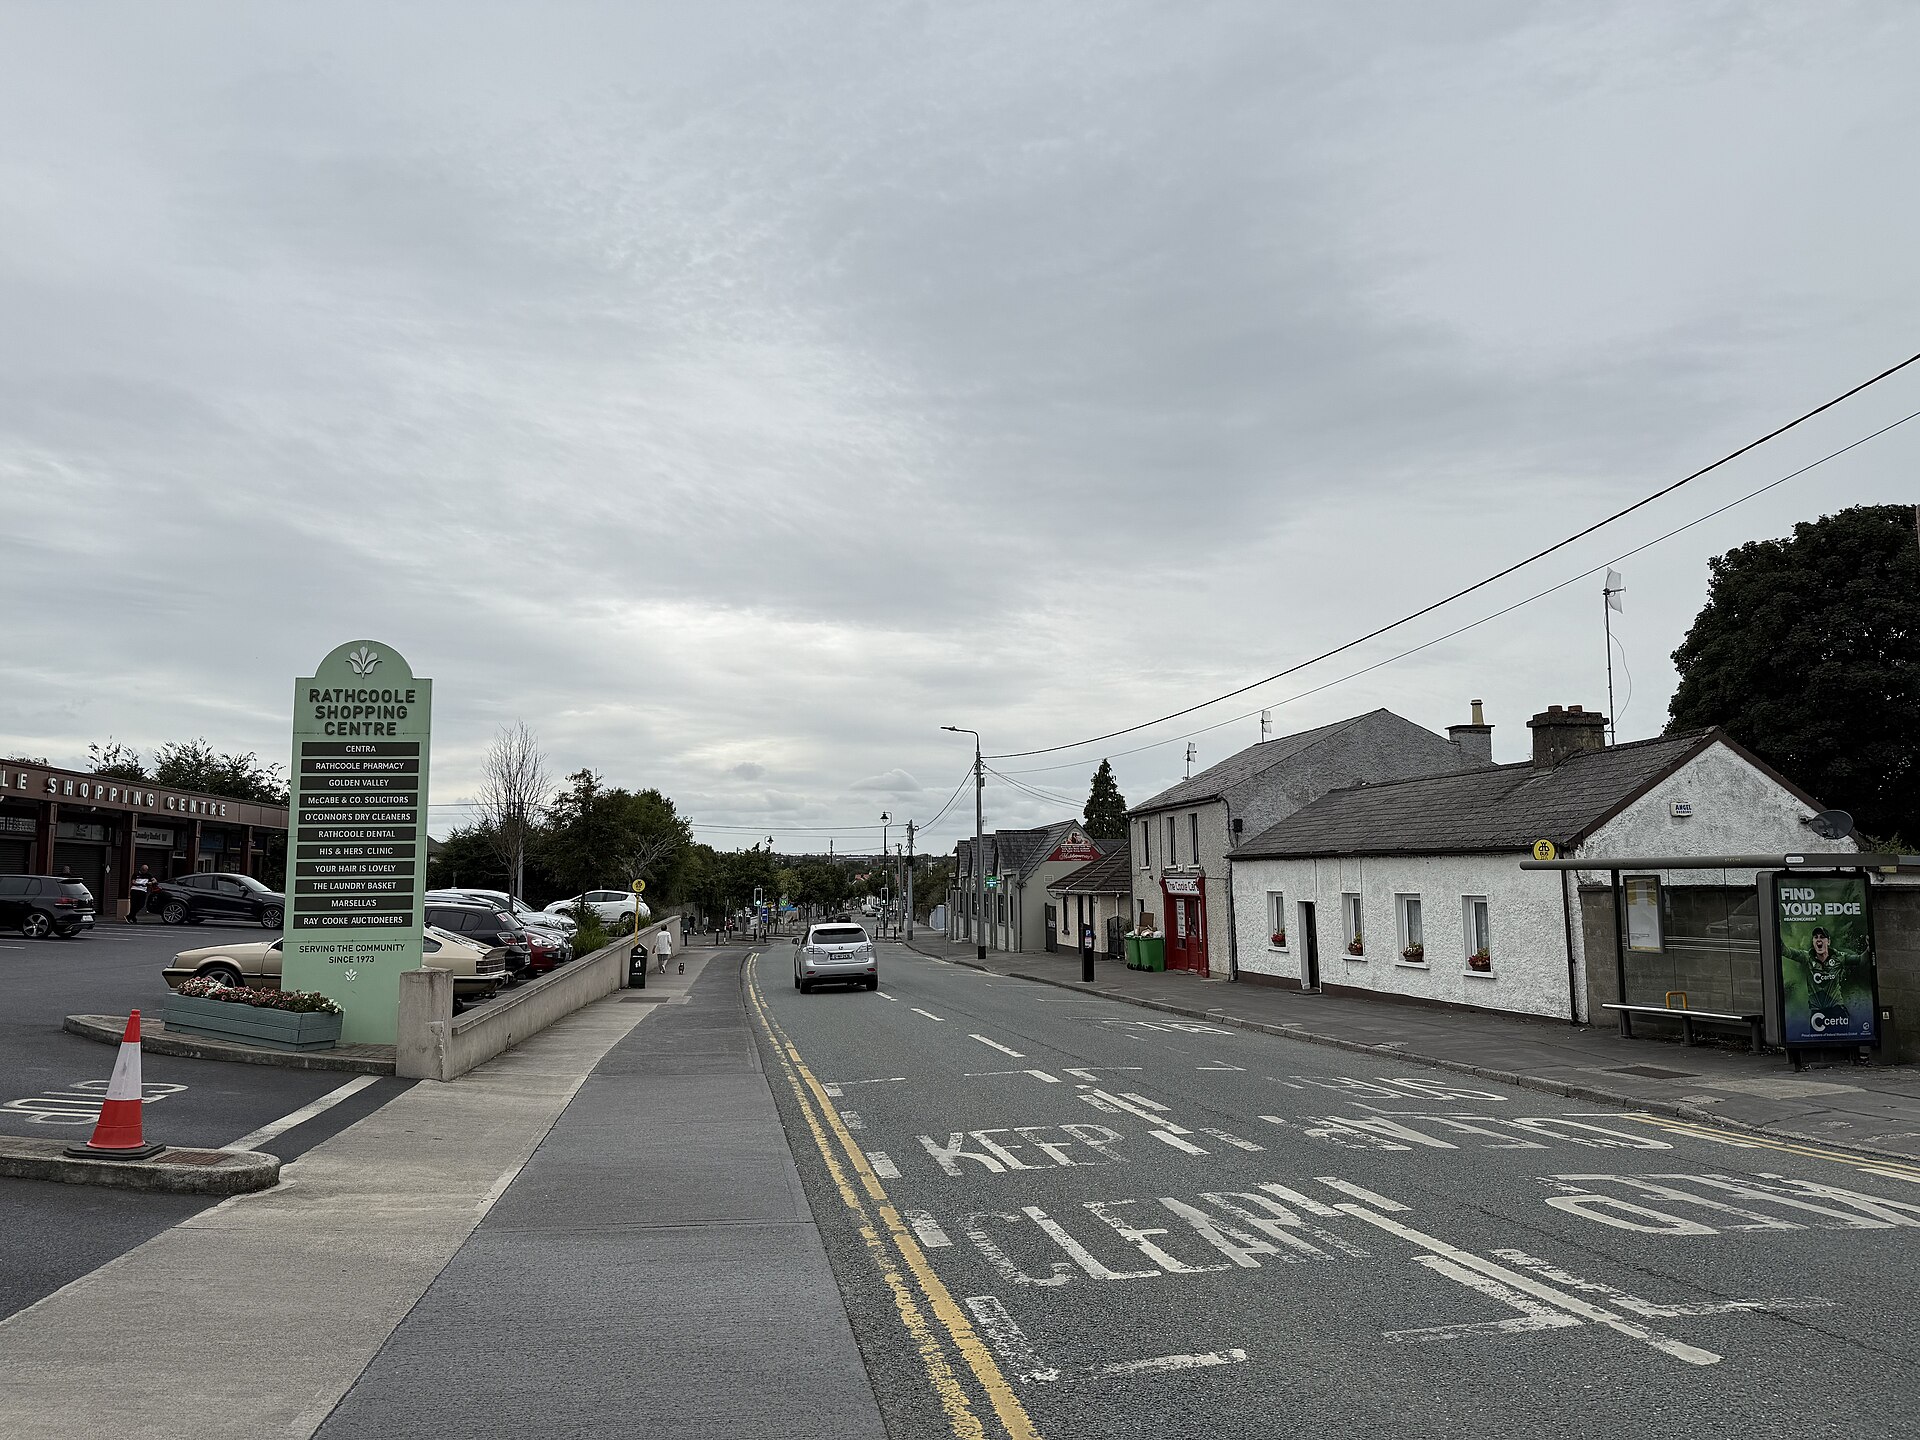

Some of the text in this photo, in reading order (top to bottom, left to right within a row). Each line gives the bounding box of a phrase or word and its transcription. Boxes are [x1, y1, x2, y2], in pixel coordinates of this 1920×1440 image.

[309, 689, 415, 703] RATHCOOLE
[315, 706, 407, 719] SHOPPING
[324, 722, 397, 735] CENTRE
[47, 778, 154, 807] SHOPPING
[167, 797, 226, 816] CENTRE
[1781, 888, 1815, 900] FIND
[1782, 903, 1861, 915] YOUR EDGE
[1824, 1016, 1848, 1025] certa
[914, 1124, 1131, 1176] KEEP
[956, 1191, 1371, 1286] CLEAR
